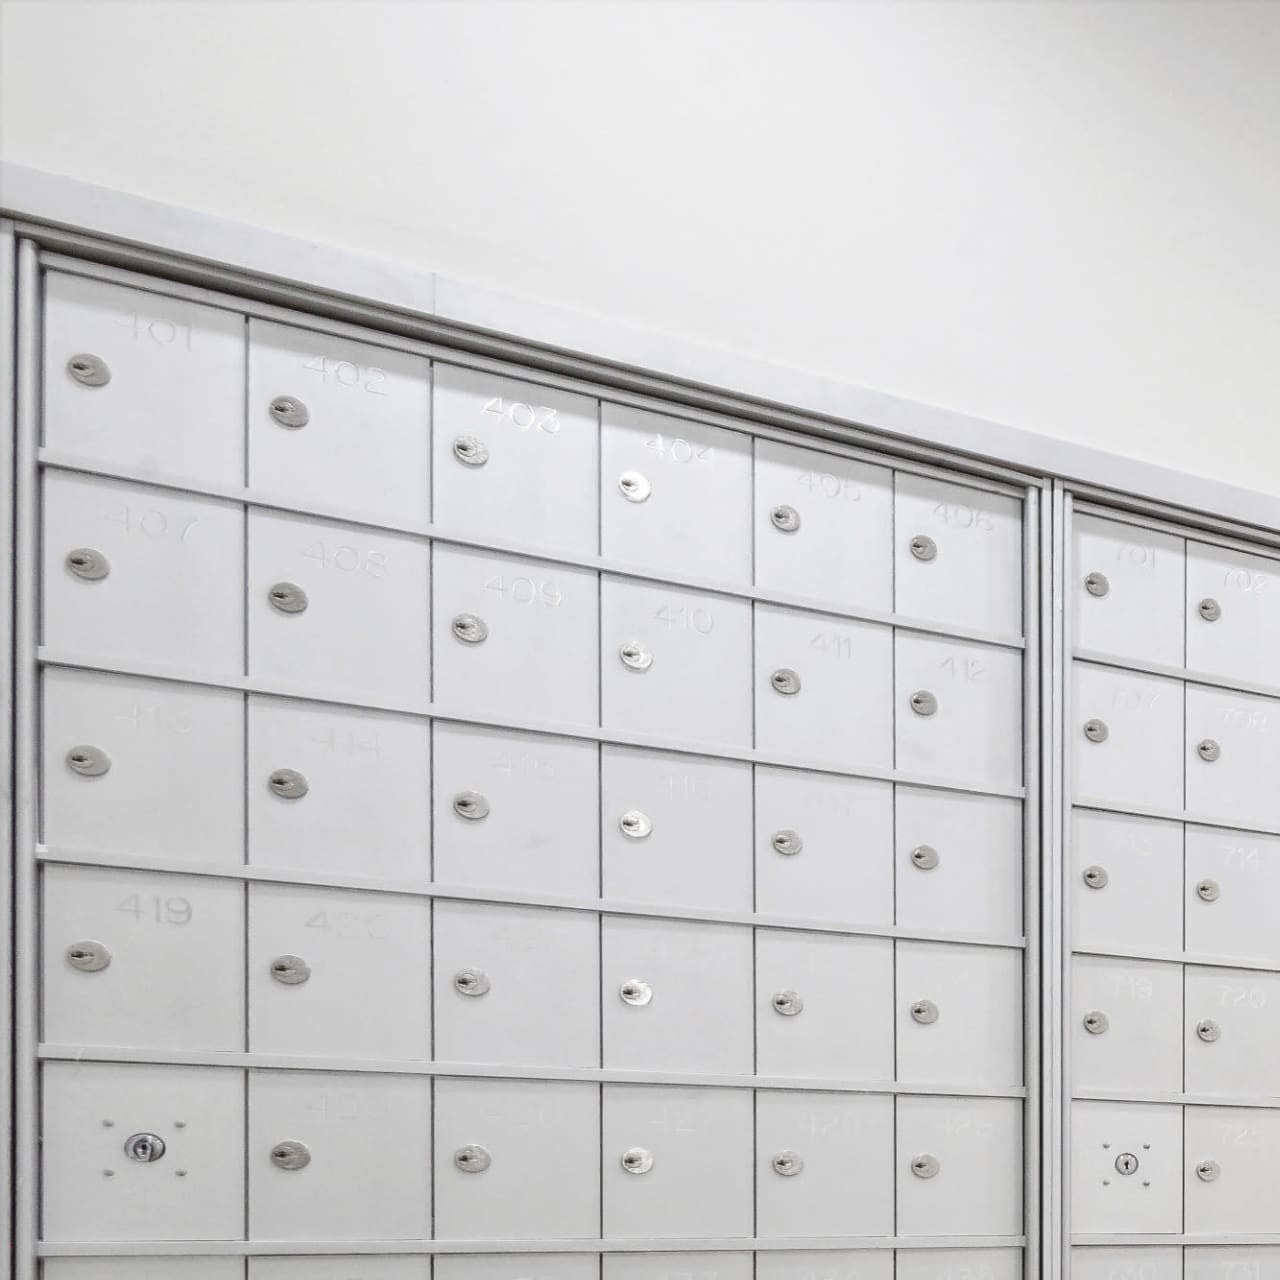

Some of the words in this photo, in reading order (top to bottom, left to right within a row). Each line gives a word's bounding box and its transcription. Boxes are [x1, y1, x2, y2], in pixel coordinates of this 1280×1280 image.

[303, 352, 388, 395] 402
[482, 394, 560, 434] 403
[485, 572, 561, 608] 409
[653, 603, 713, 634] 410
[810, 632, 851, 658] 411
[115, 894, 193, 926] 419
[1220, 987, 1265, 1007] 720
